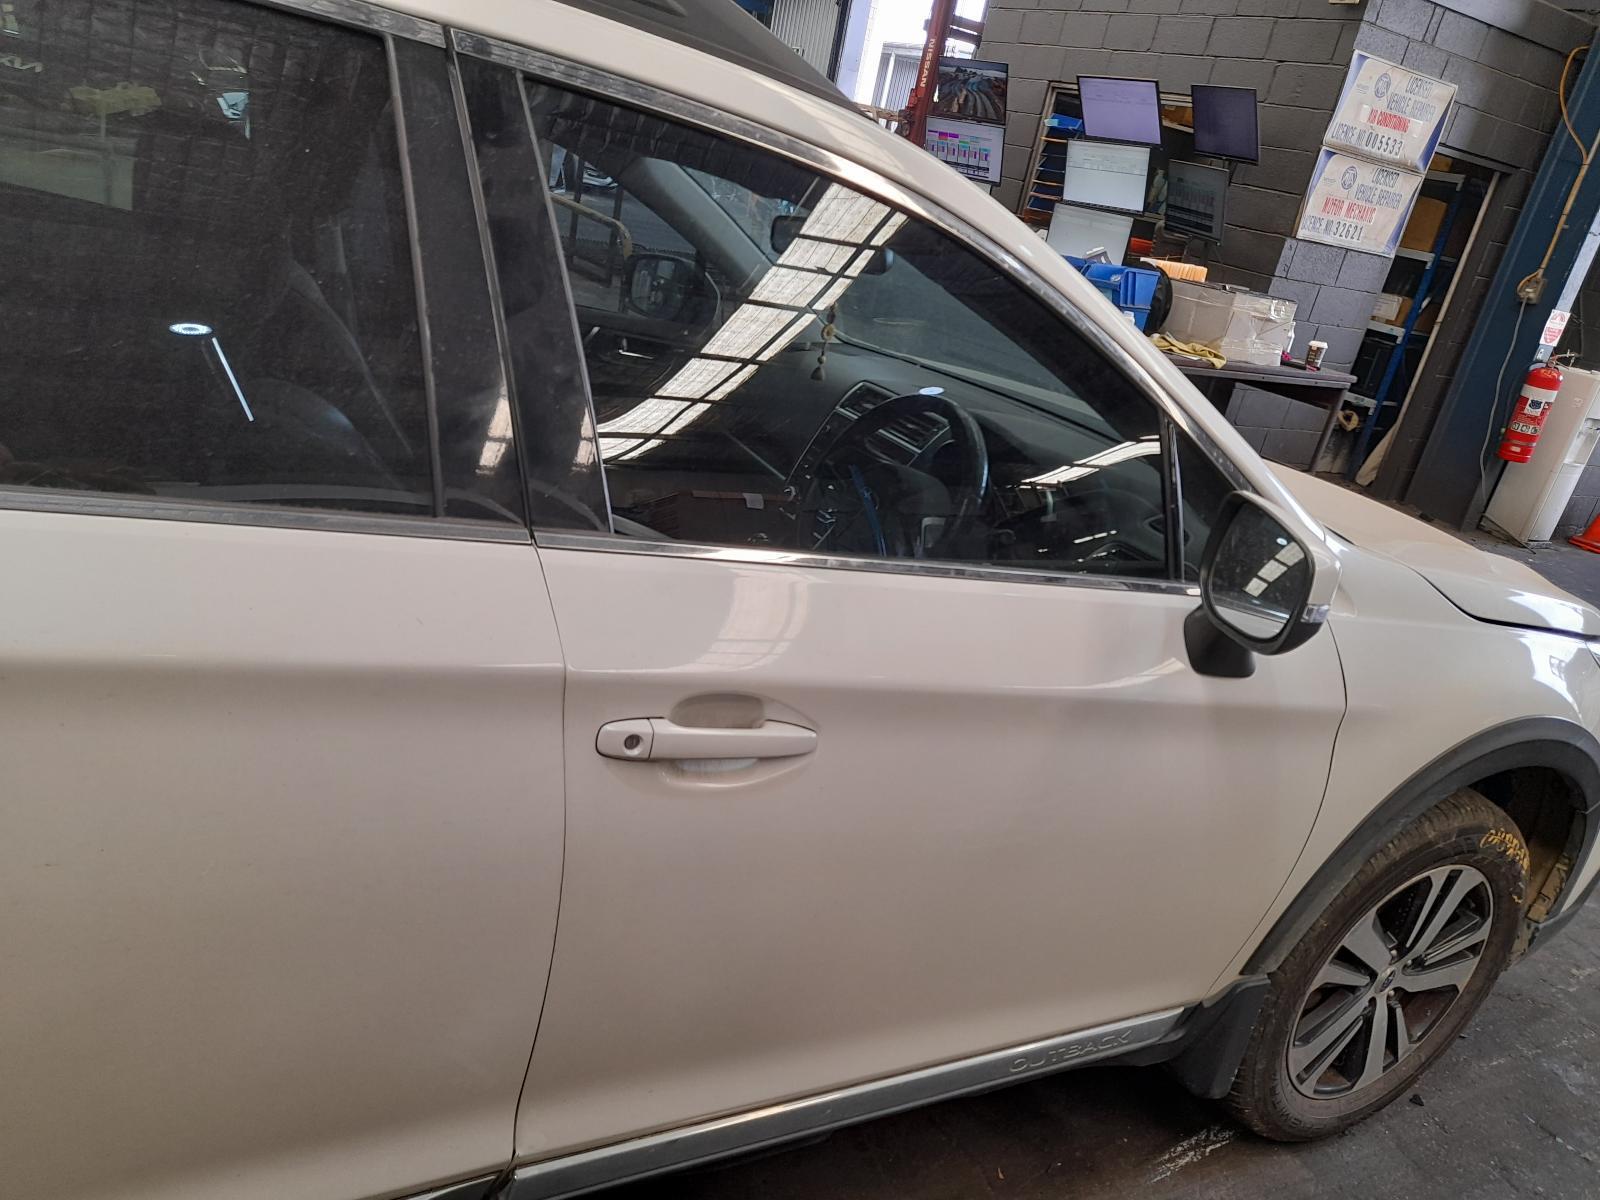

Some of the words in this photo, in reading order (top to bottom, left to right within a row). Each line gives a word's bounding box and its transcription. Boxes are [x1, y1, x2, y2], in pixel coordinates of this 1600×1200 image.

[919, 38, 937, 88] NISSAN
[1386, 92, 1411, 115] VEHICLE
[1376, 111, 1411, 133] CONDITIONING
[1365, 132, 1404, 156] 005533
[1372, 167, 1400, 189] LICENSED
[1354, 183, 1378, 204] VEHICLE
[1376, 187, 1403, 210] REPAIRER
[1321, 196, 1345, 217] MOTOR
[1344, 201, 1377, 224] MECHANIC
[1333, 221, 1364, 241] 32621
[1008, 1030, 1132, 1073] OUTBACK
